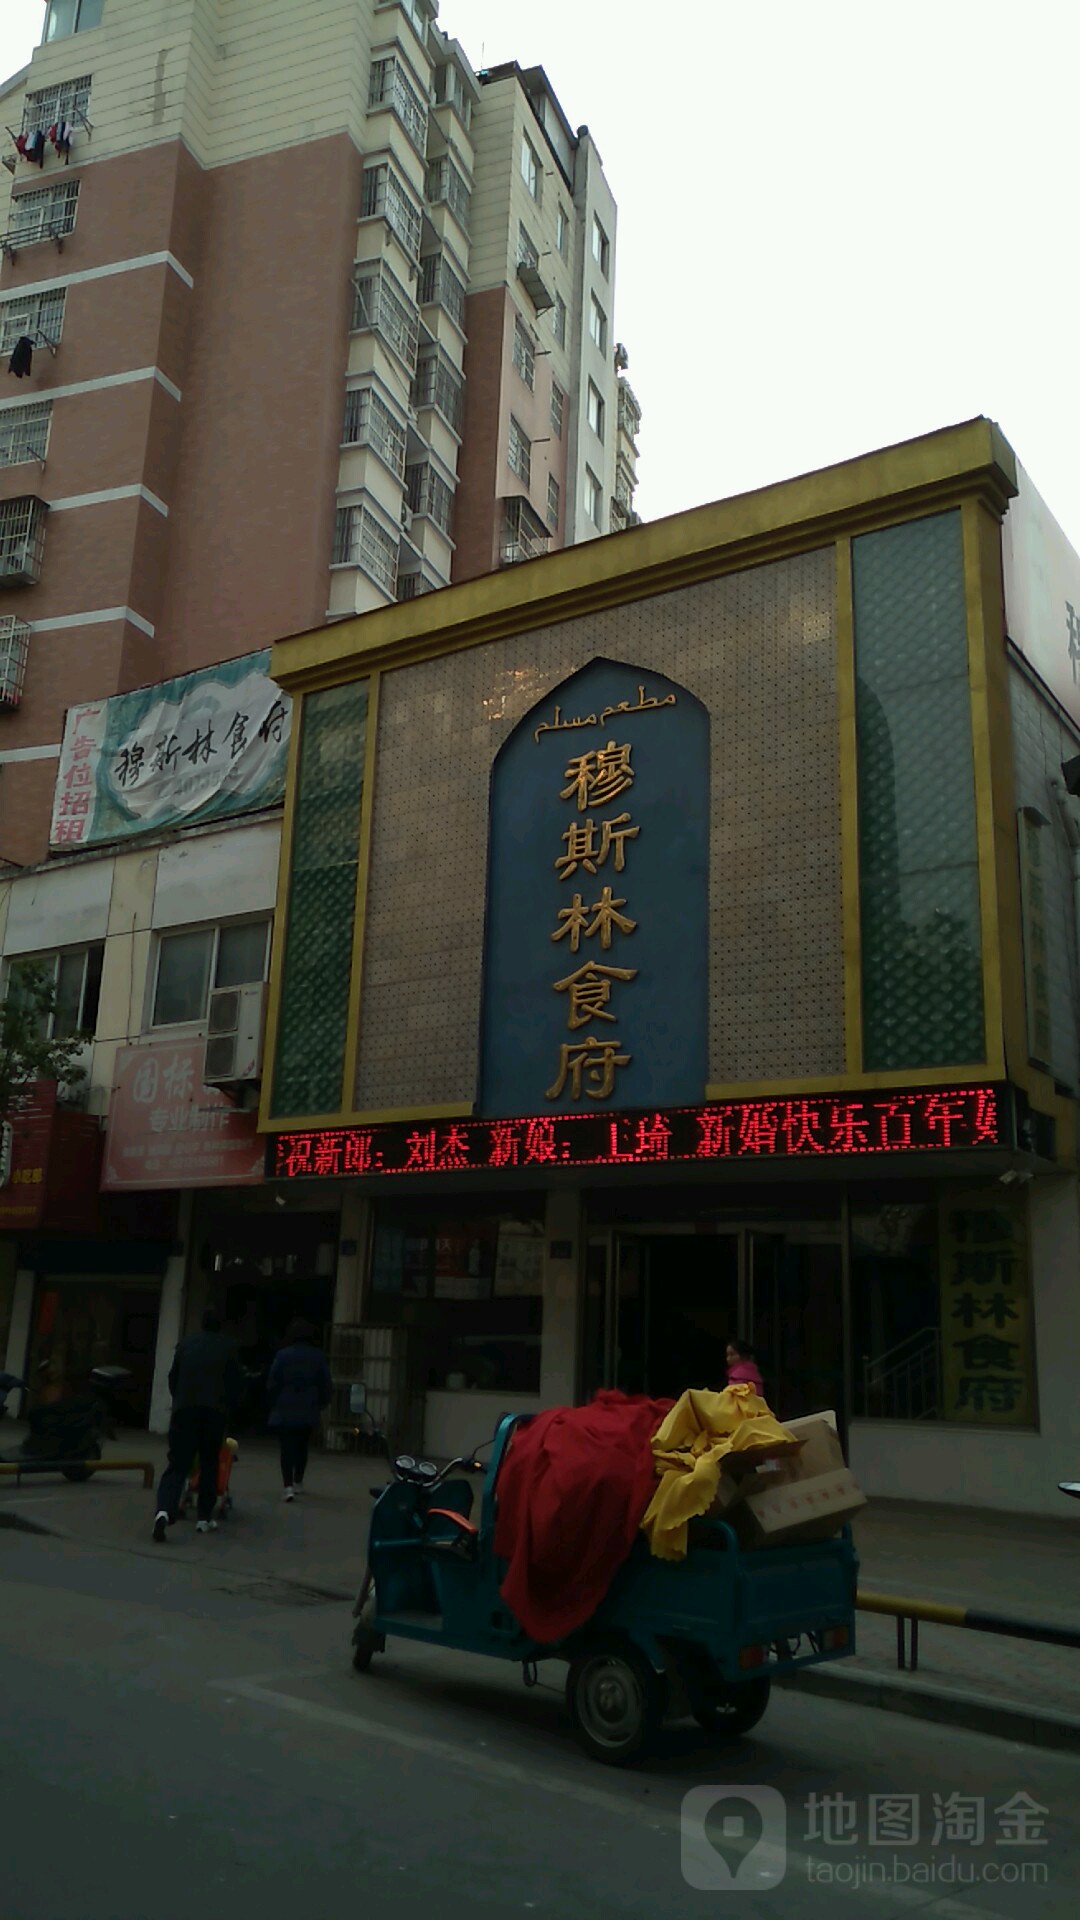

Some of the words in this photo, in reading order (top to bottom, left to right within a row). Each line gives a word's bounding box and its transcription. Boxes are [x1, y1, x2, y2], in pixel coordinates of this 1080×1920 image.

[534, 705, 598, 743] مسلم
[600, 685, 677, 727] مطعم
[54, 708, 100, 842] 广告位招租
[545, 740, 640, 1100] 穆斯林食府
